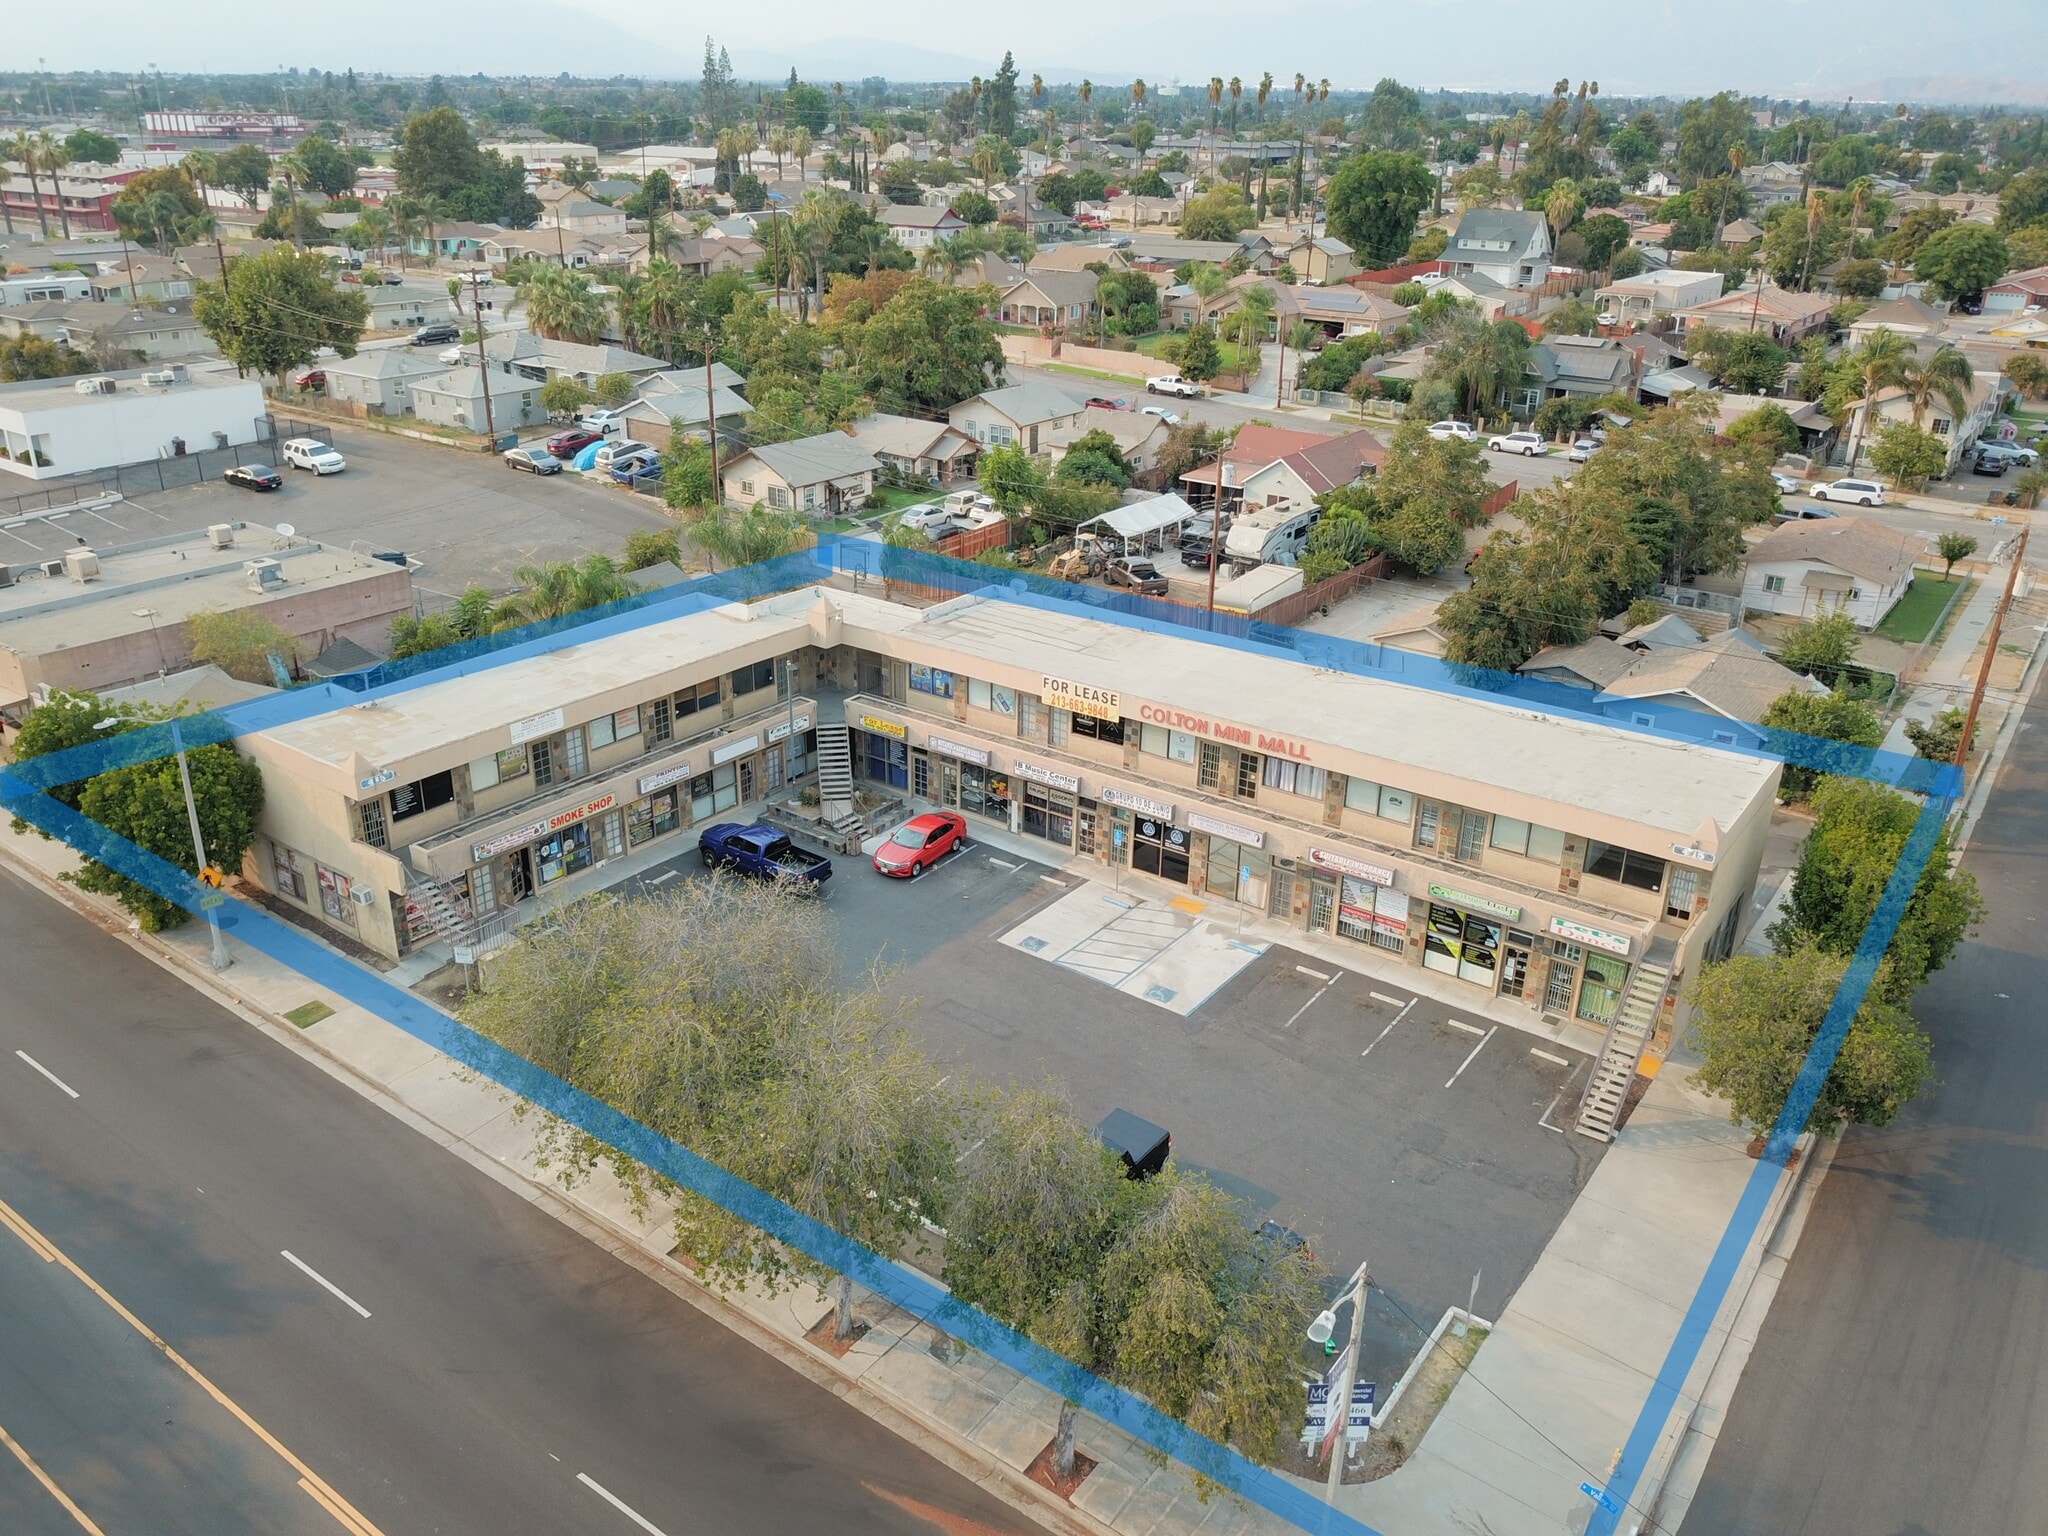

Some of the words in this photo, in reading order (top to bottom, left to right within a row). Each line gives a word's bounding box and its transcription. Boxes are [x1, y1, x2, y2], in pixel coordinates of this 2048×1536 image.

[1043, 677, 1069, 695] FOR
[1074, 685, 1118, 707] LEASE
[1051, 693, 1109, 719] 213-663-9848
[864, 715, 878, 726] For
[880, 720, 905, 734] Lease
[1139, 704, 1209, 735] COLTON
[1213, 722, 1252, 745] MINI
[1257, 734, 1311, 761] MALL
[656, 762, 689, 778] PRINTING
[1025, 764, 1048, 777] Music
[1049, 771, 1077, 785] Center
[550, 807, 584, 829] SMOKE
[587, 795, 613, 814] SHOP
[1115, 791, 1134, 804] GRUPO
[1143, 799, 1151, 809] DE
[1152, 801, 1170, 815] JUNIO
[1319, 850, 1350, 865] SUITABLE
[1350, 859, 1393, 879] INSURANCE
[1556, 918, 1626, 945] Let's
[1557, 926, 1623, 951] Dance
